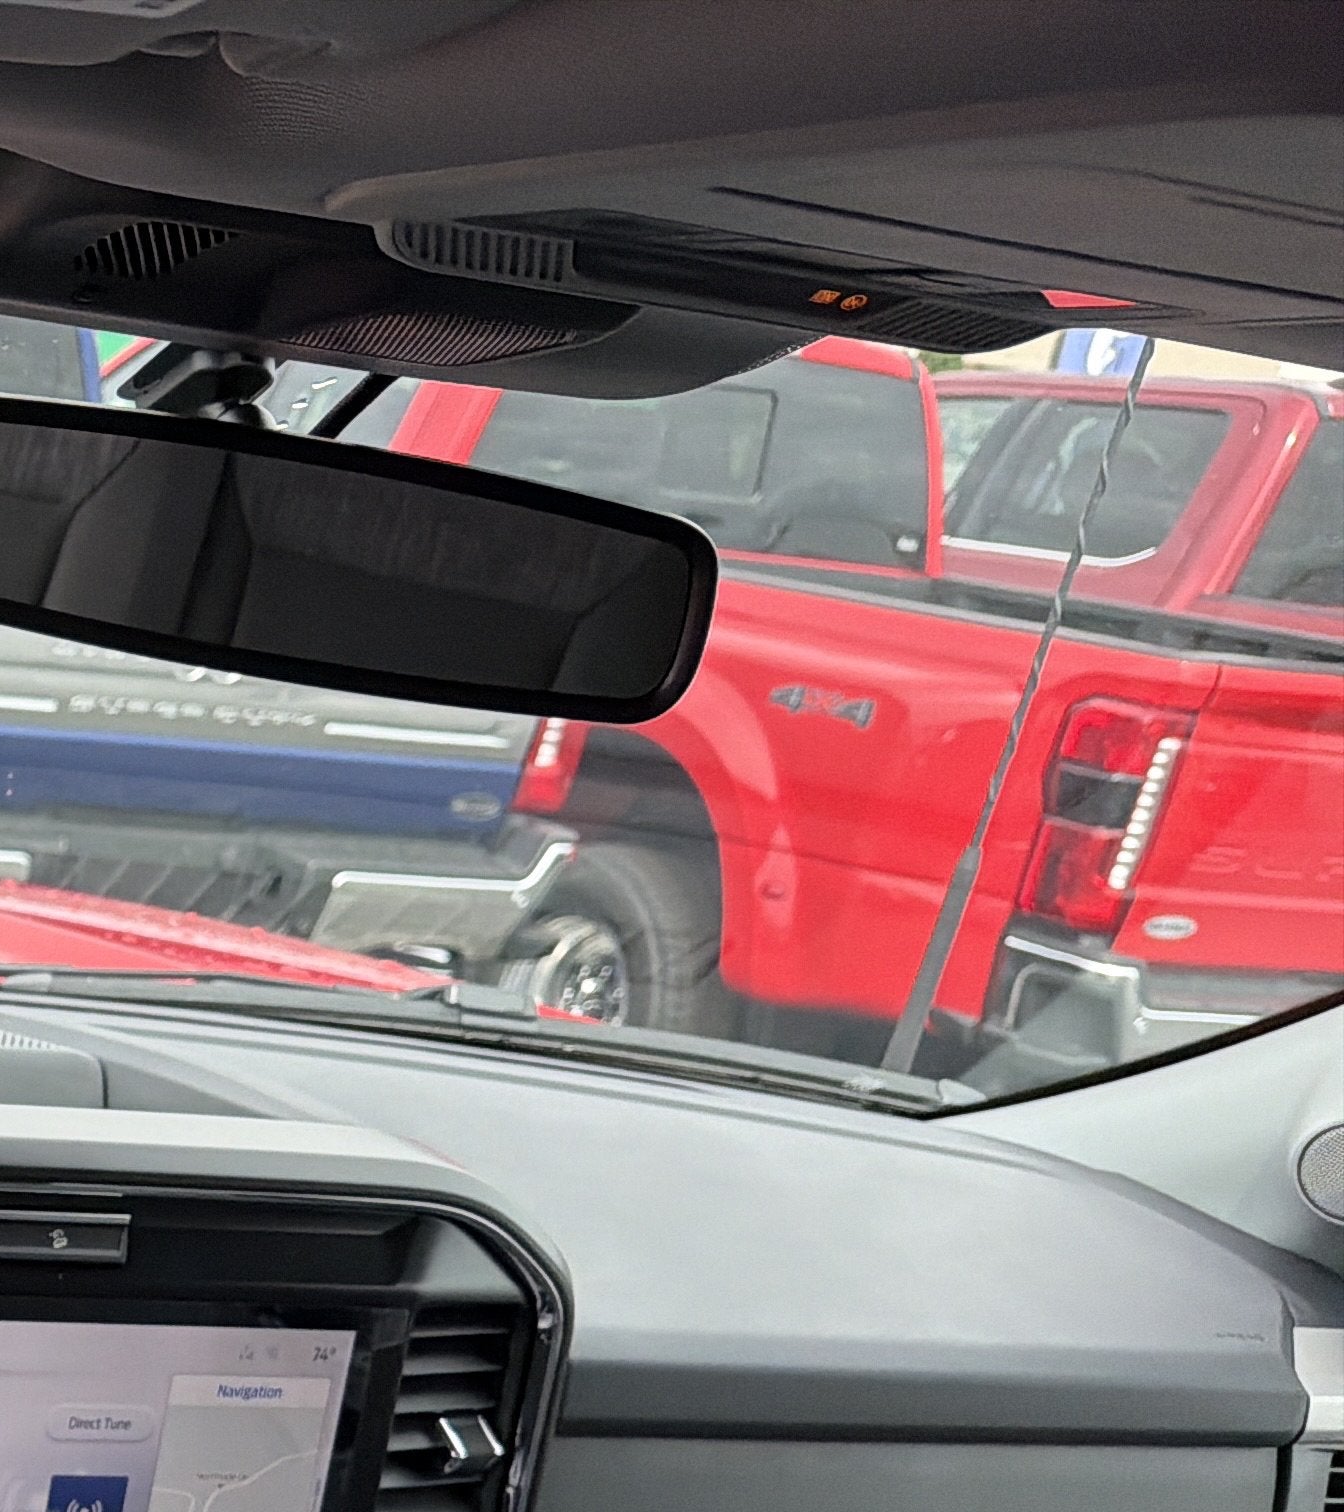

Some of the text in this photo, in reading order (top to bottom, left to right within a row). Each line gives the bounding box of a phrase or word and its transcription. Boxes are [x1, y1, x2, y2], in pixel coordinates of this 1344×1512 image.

[216, 1383, 284, 1400] Navigation
[68, 1416, 132, 1431] Direct Tune
